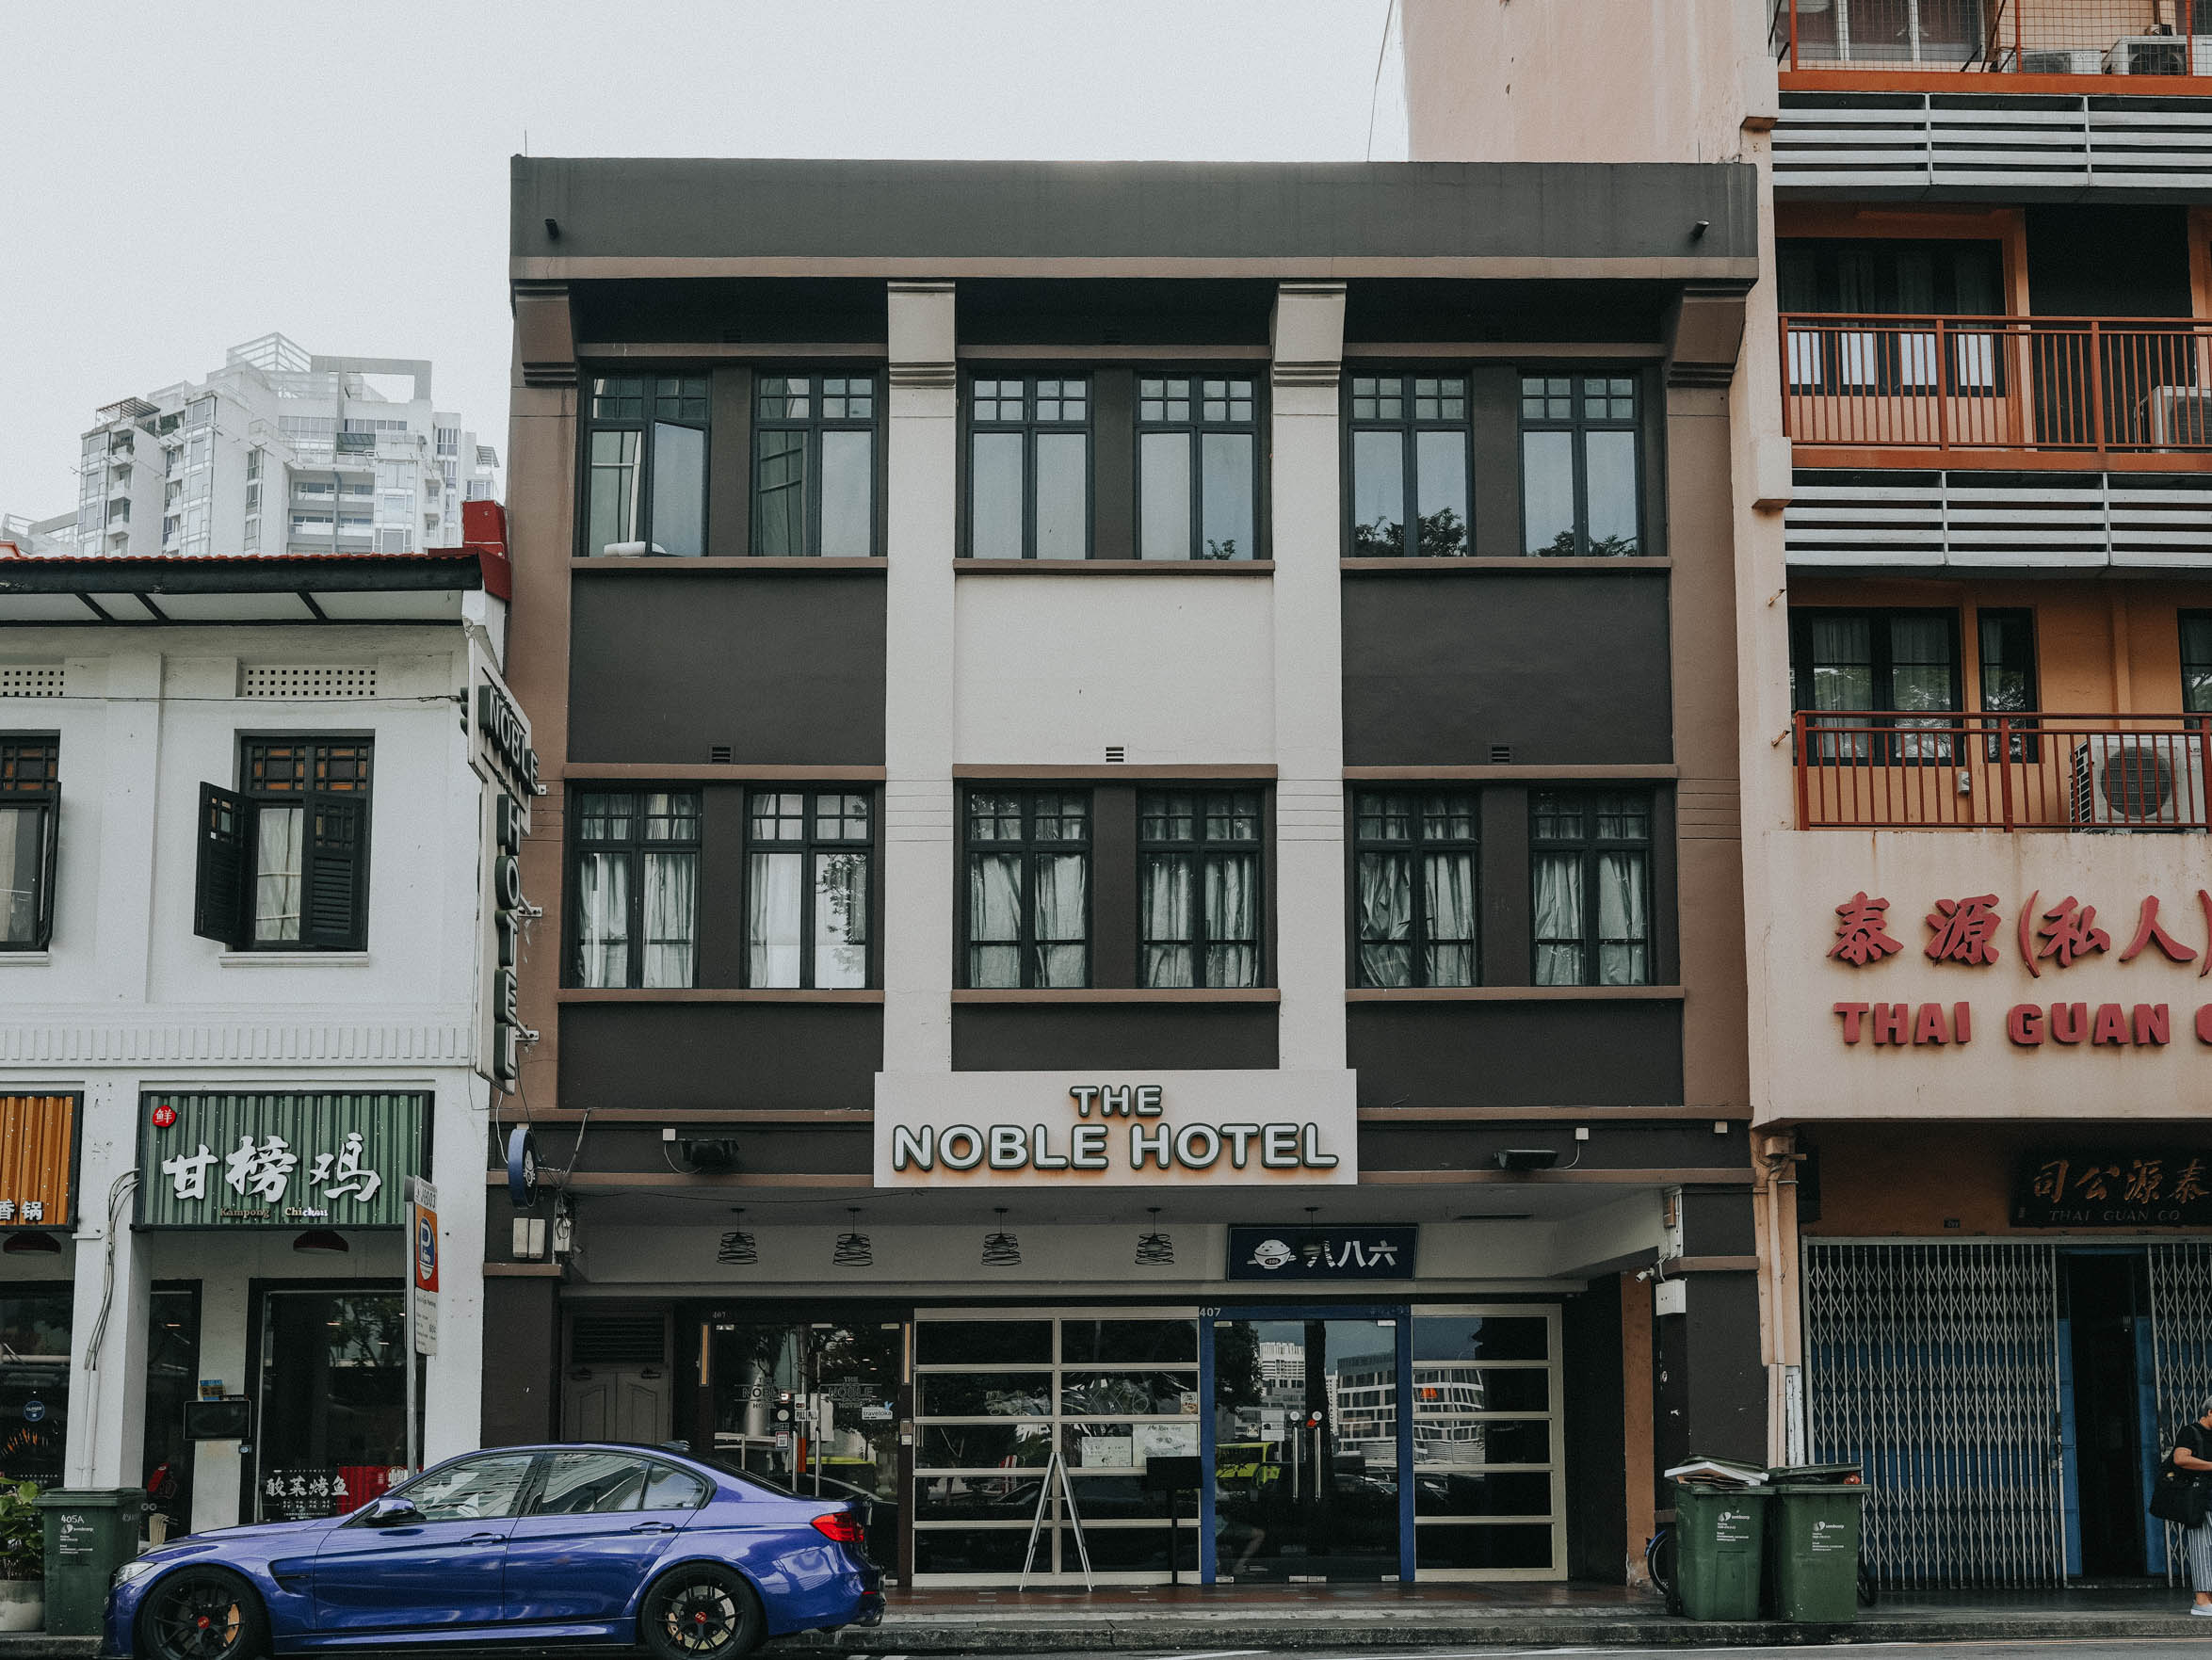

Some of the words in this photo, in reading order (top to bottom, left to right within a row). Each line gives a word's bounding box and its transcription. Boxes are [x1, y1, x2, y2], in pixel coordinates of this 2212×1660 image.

[478, 685, 539, 796] NOBLE
[494, 794, 520, 1080] HOTEL
[1833, 1002, 1971, 1045] THAI
[2008, 1003, 2171, 1045] GUAN
[1070, 1085, 1163, 1117] THE
[893, 1124, 1109, 1170] NOBLE
[1129, 1122, 1339, 1168] HOTEL
[162, 1132, 382, 1202] 甘榜鸡
[219, 1207, 271, 1218] Kampong
[284, 1206, 329, 1217] Chicken
[2049, 1210, 2090, 1221] THAI
[2104, 1210, 2148, 1221] GUAN
[712, 1311, 726, 1319] 407
[1199, 1307, 1221, 1317] 407
[266, 1475, 349, 1497] 酸菜烤鱼
[60, 1514, 85, 1523] 405A
